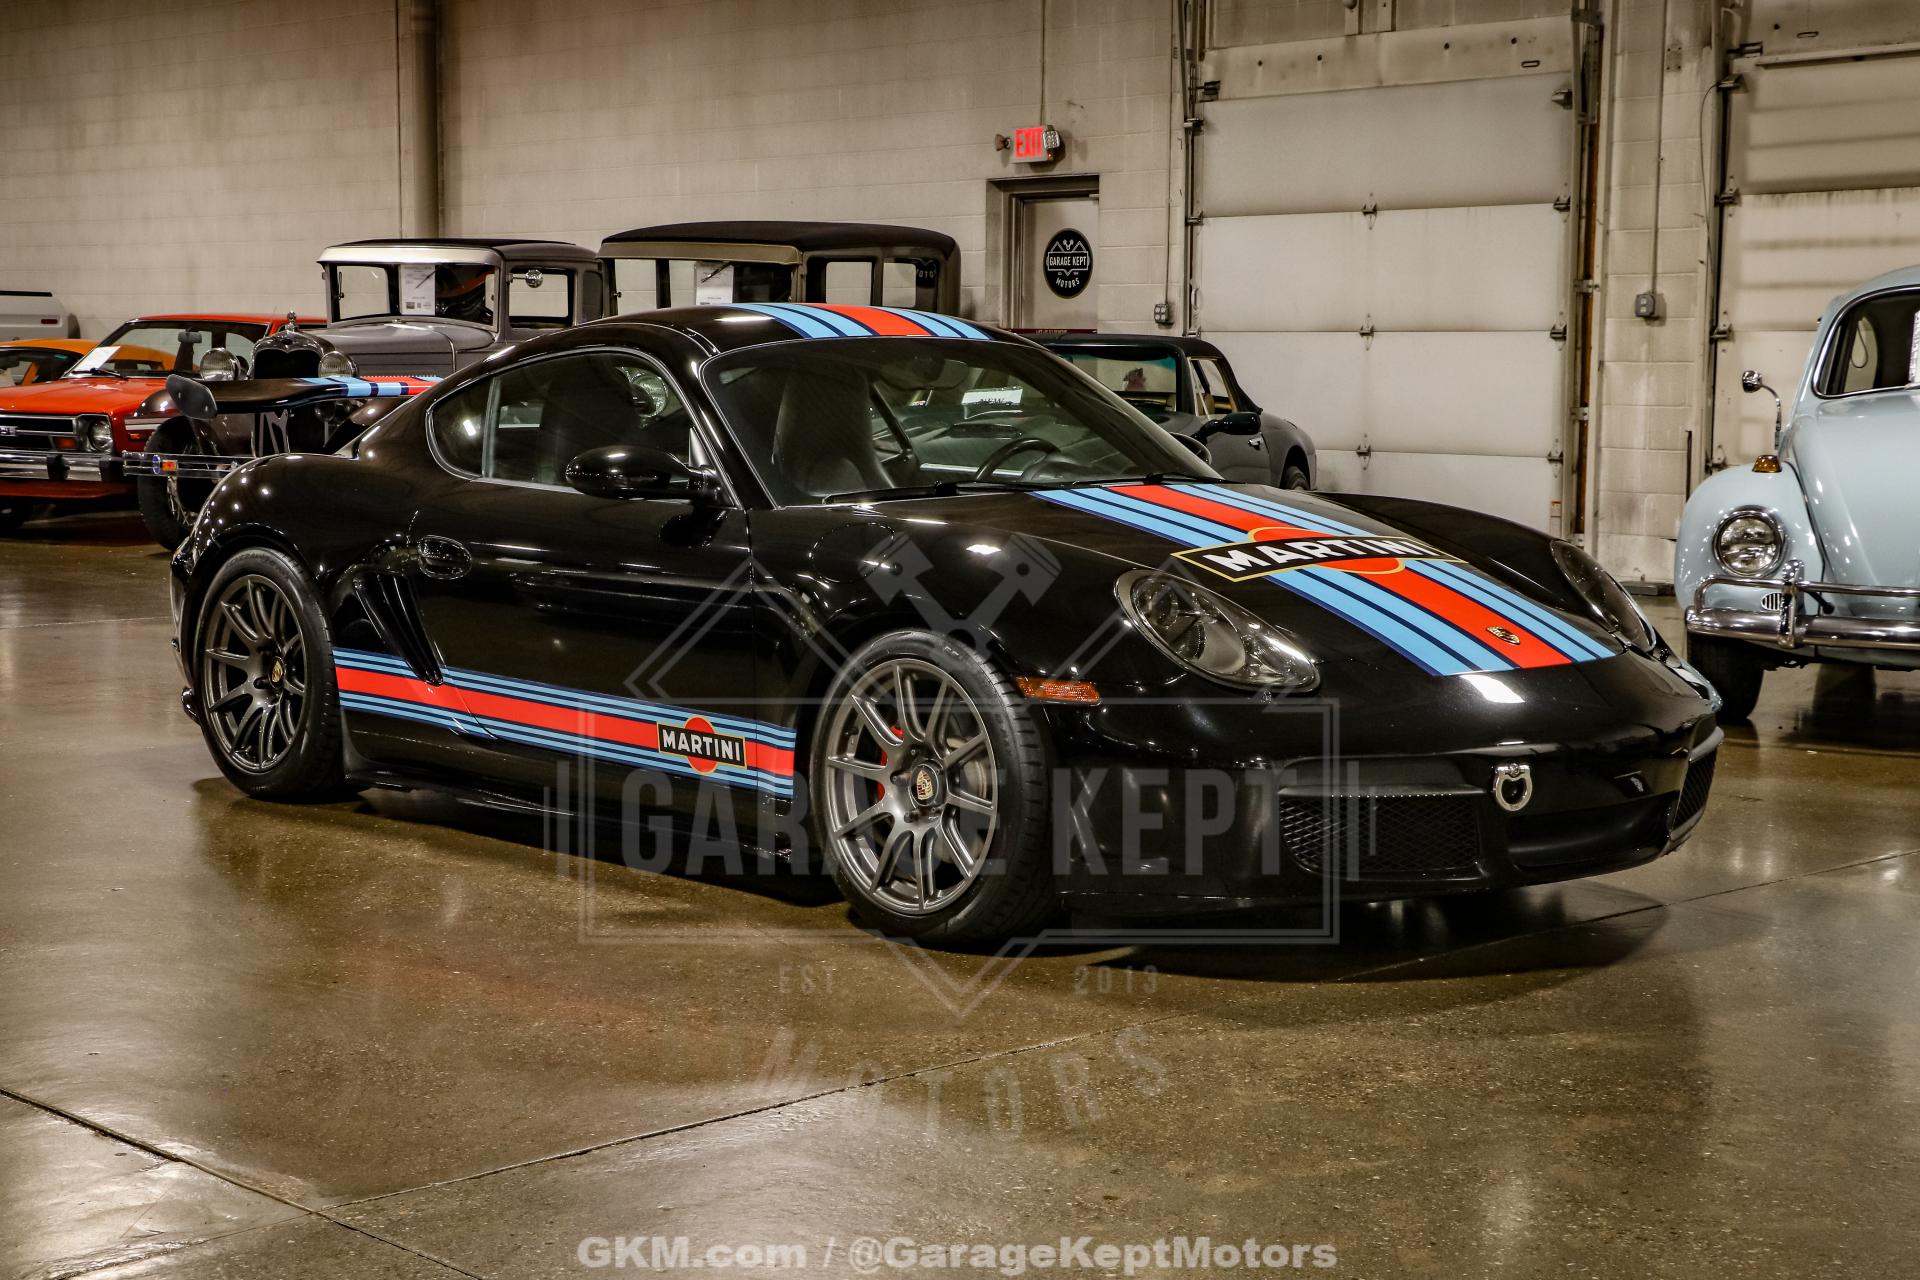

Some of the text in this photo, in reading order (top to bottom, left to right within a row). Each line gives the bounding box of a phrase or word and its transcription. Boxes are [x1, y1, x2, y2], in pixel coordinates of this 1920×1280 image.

[1015, 127, 1044, 158] EXIT
[1049, 256, 1087, 266] GARAGE KEPT
[1056, 277, 1080, 288] MOTORS
[1203, 538, 1440, 572] MARTINI
[662, 729, 741, 761] MARTINI
